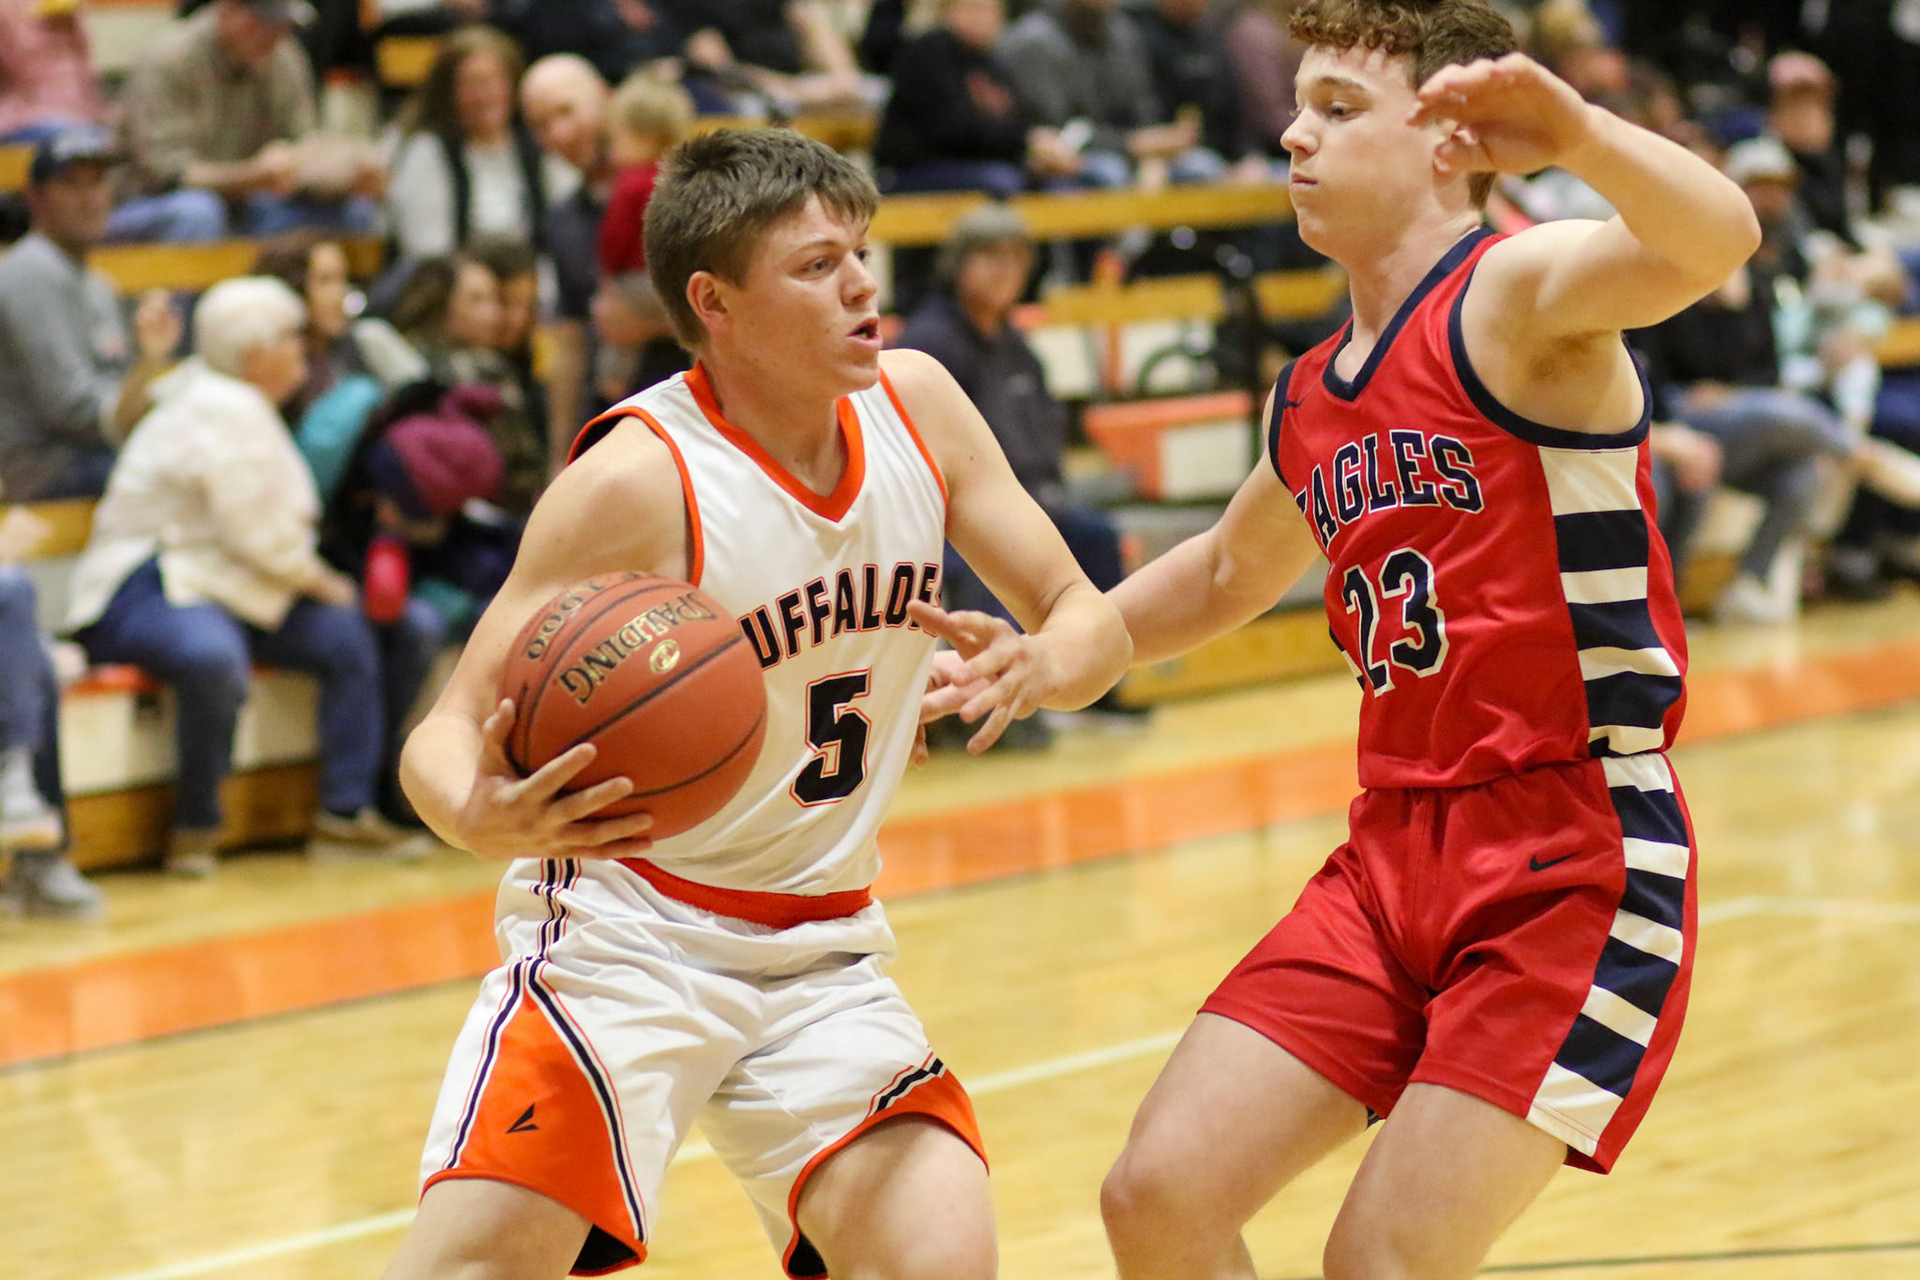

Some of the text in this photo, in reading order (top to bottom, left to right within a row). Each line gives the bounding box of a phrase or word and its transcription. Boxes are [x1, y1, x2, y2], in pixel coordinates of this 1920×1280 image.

[1294, 430, 1484, 553] AGLES
[559, 592, 717, 706] SPALDING
[737, 562, 943, 671] UFFALOE
[1342, 547, 1450, 698] 23
[789, 666, 872, 808] 5
